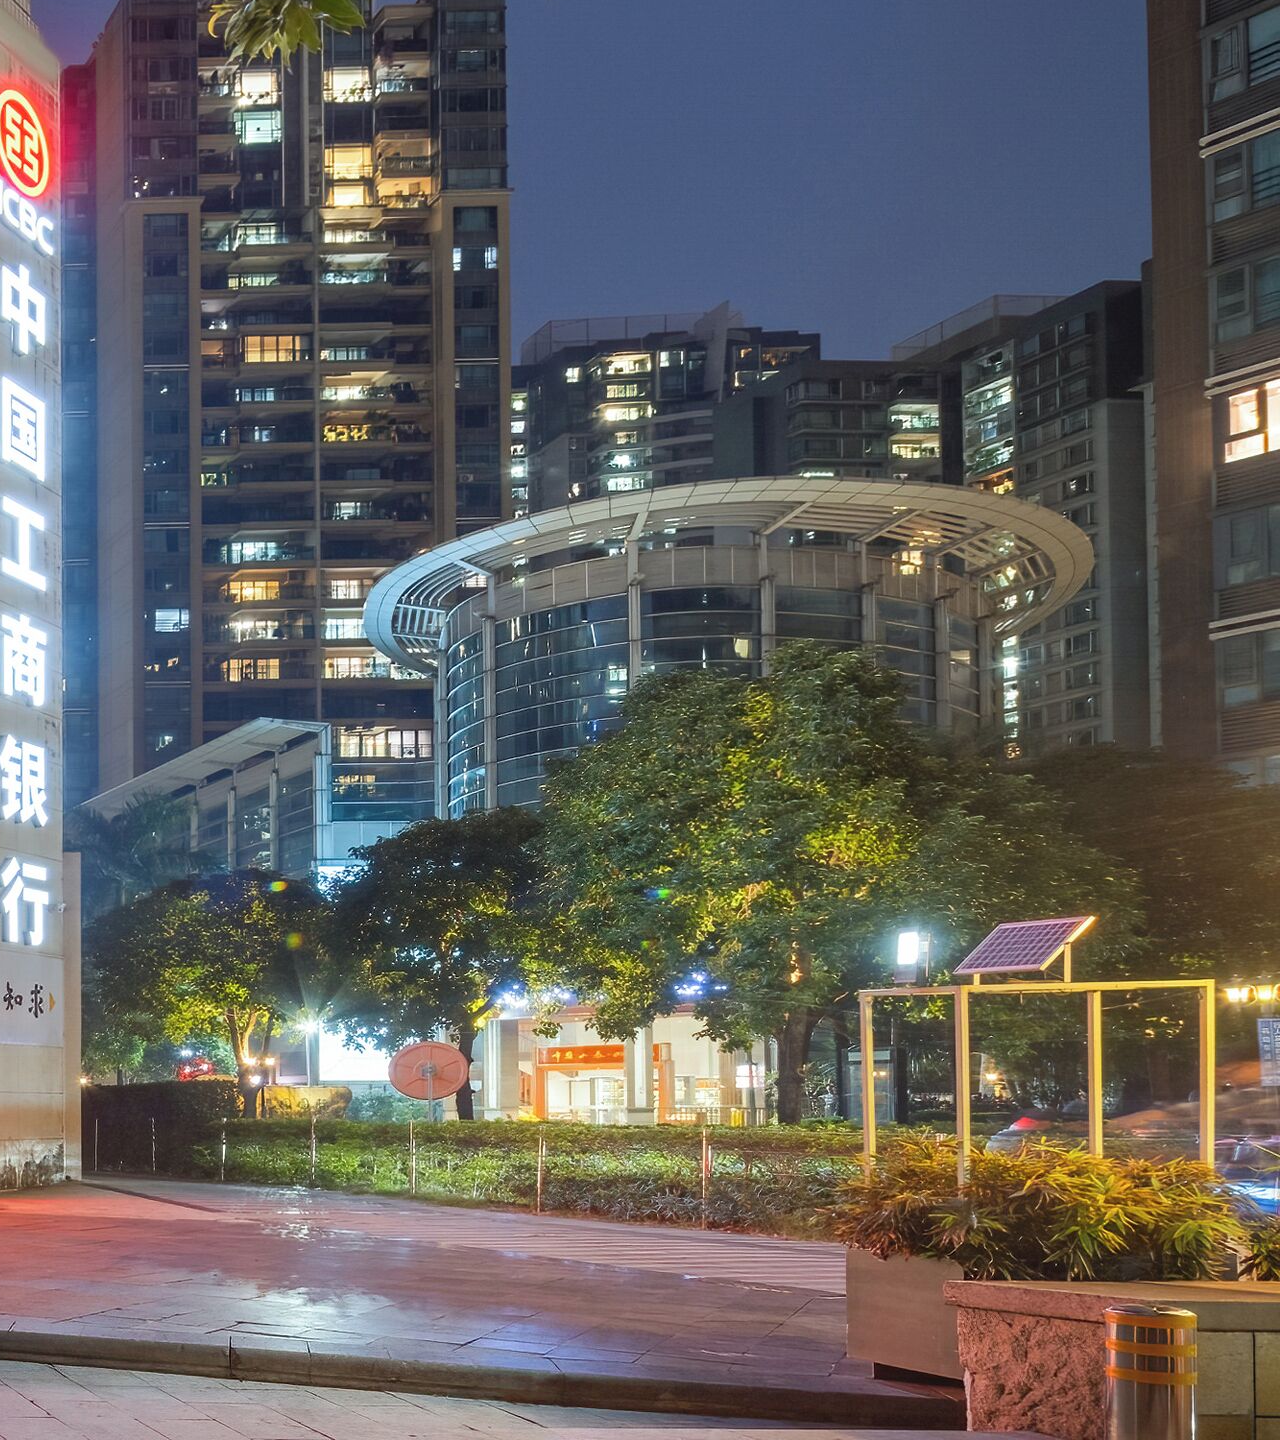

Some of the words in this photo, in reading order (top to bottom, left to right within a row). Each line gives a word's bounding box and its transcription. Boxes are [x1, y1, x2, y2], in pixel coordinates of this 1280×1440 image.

[0, 262, 49, 946] 中国工商银行
